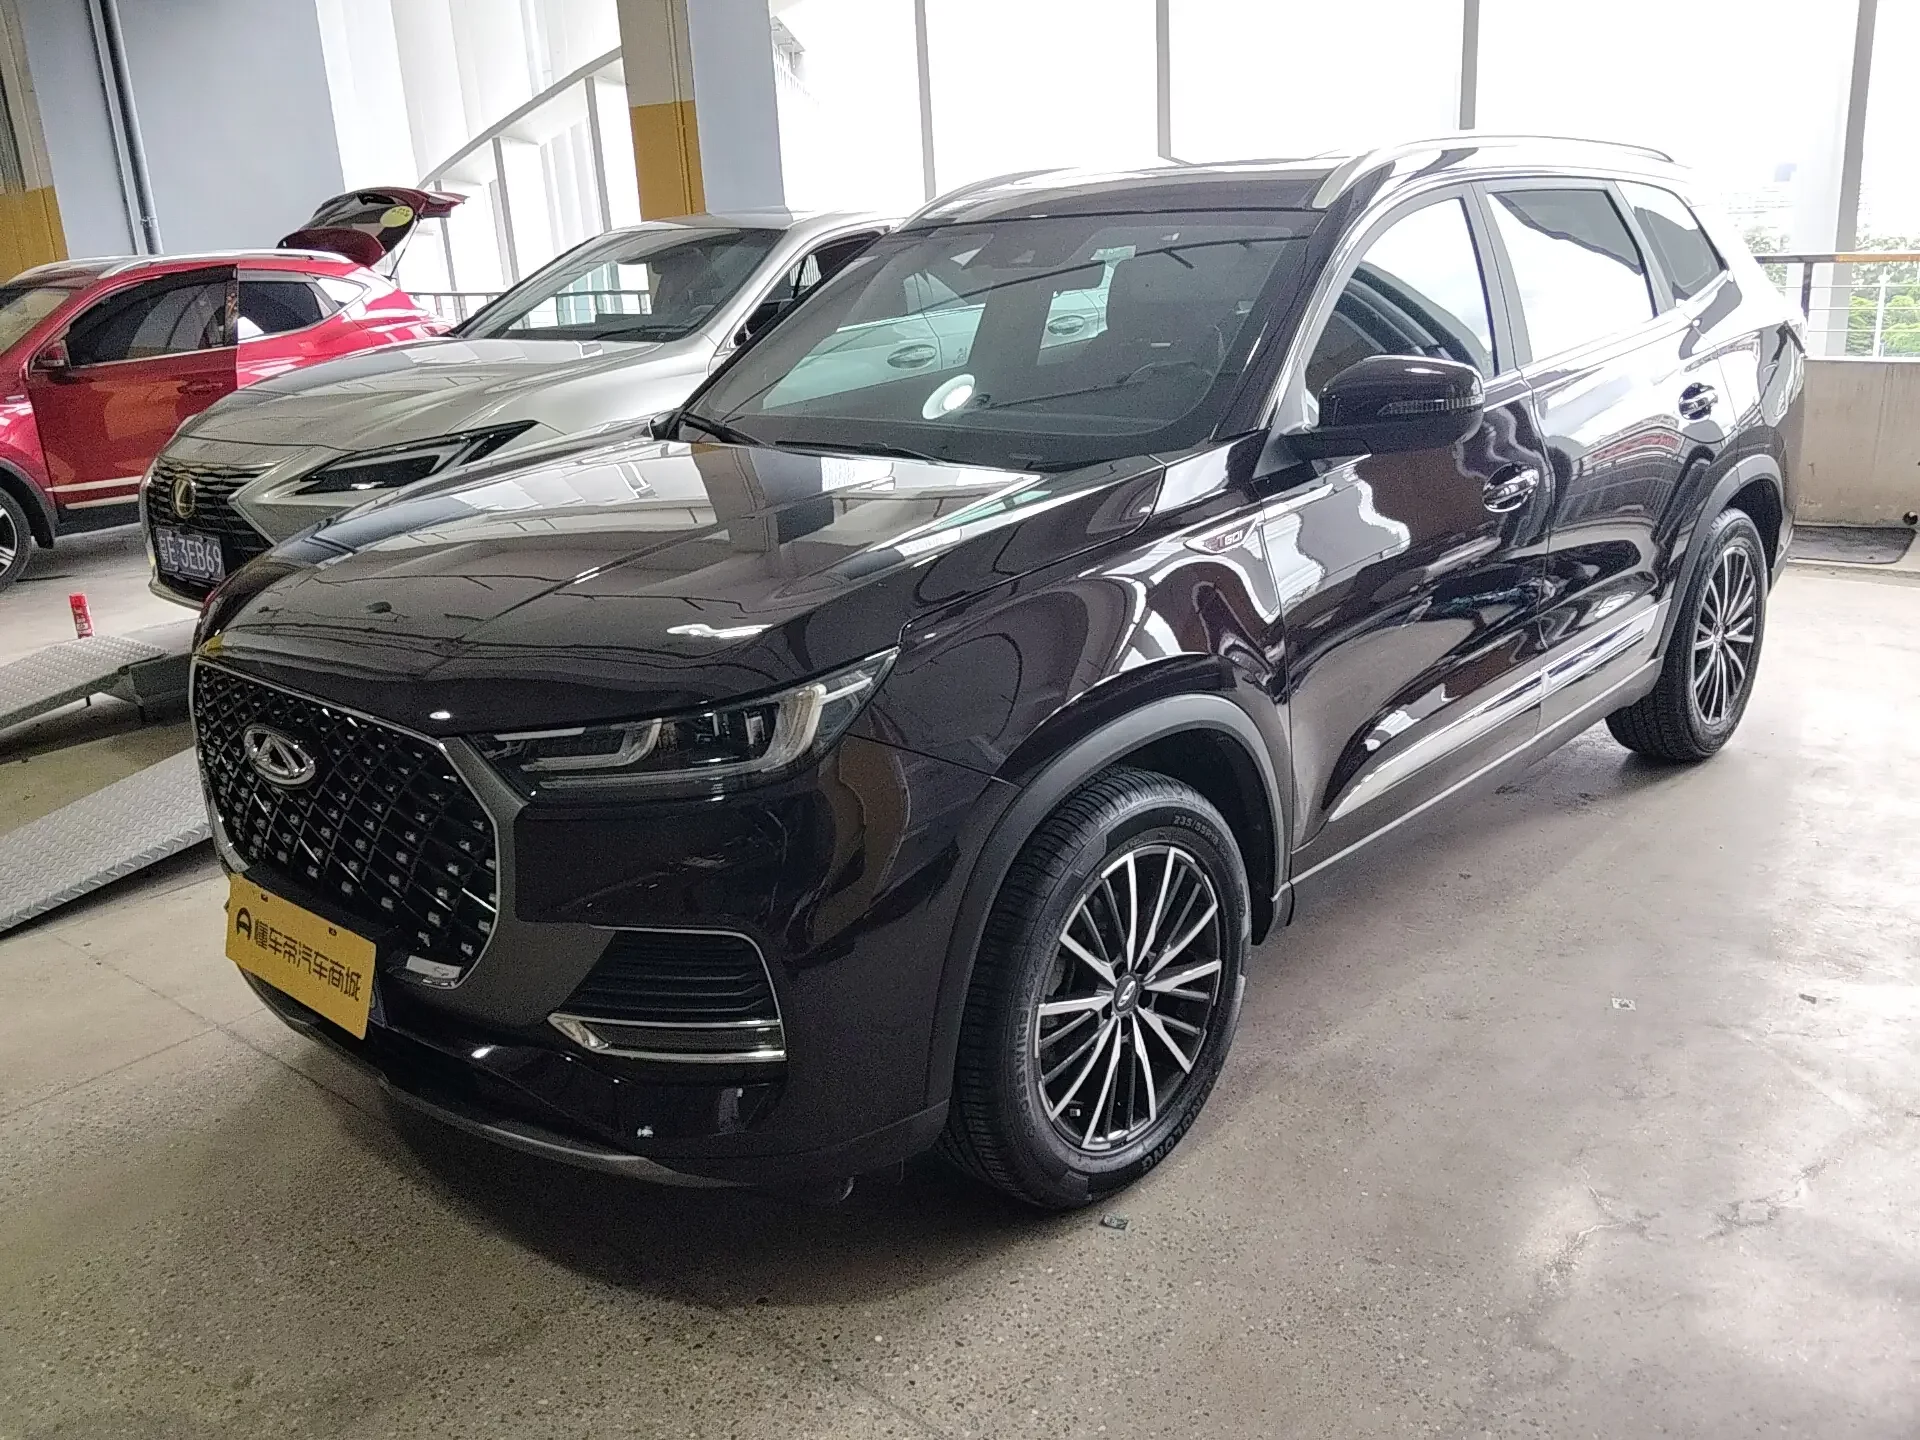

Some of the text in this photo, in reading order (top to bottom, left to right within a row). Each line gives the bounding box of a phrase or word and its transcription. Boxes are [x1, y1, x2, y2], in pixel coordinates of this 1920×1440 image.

[254, 919, 361, 1002] 懂车帝汽车商城
